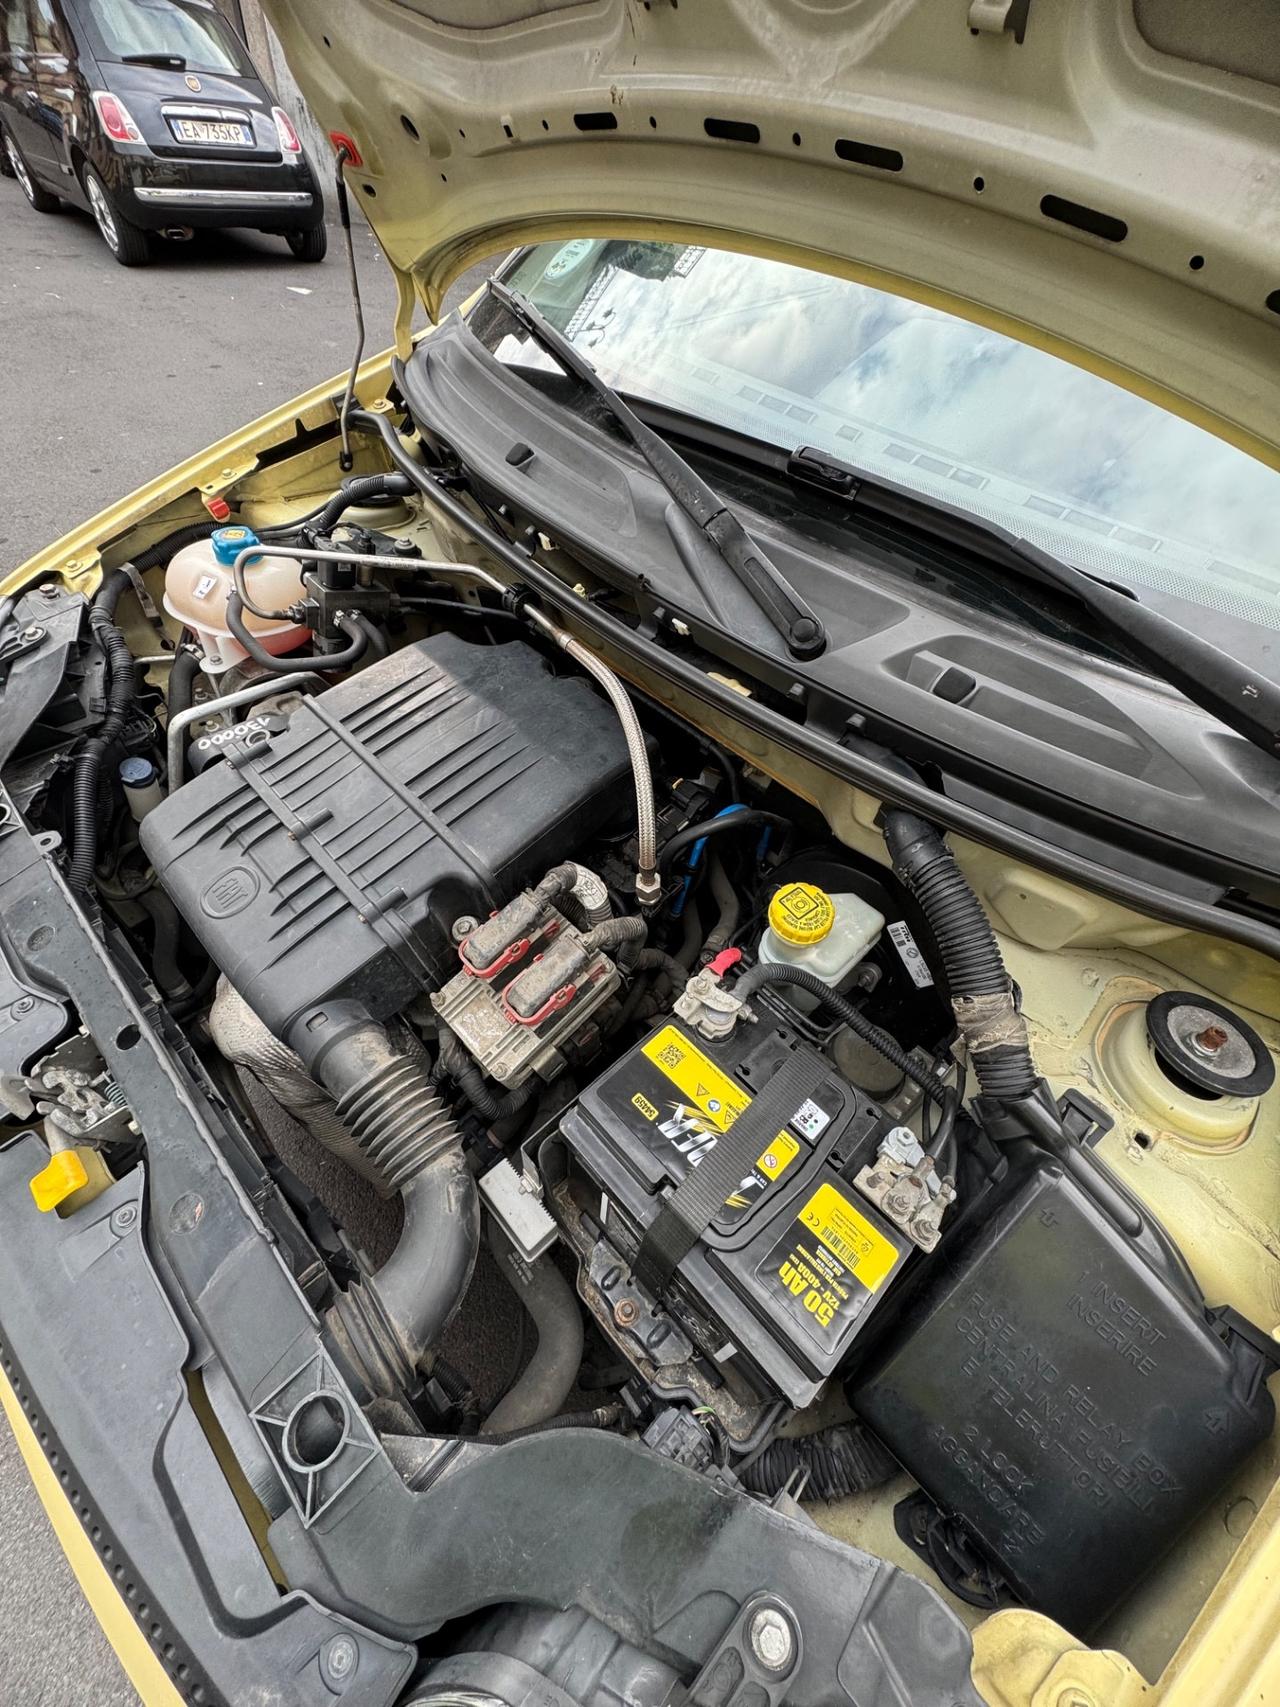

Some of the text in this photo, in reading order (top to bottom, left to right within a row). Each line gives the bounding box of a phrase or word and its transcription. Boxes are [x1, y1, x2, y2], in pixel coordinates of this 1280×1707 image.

[198, 717, 270, 750] 130000
[635, 1097, 656, 1117] 54459
[778, 1261, 809, 1296] Ah
[797, 1262, 821, 1289] 400A
[803, 1289, 834, 1328] 50
[822, 1290, 841, 1310] 12V
[1092, 1280, 1167, 1345] INSERT
[1065, 1293, 1158, 1376] INSERIRE
[954, 1316, 1066, 1432] CENTRALINA
[966, 1291, 1017, 1344] FUSE
[1018, 1344, 1060, 1385] AND
[1063, 1384, 1134, 1450] RELAY
[978, 1439, 1035, 1498] LOCK
